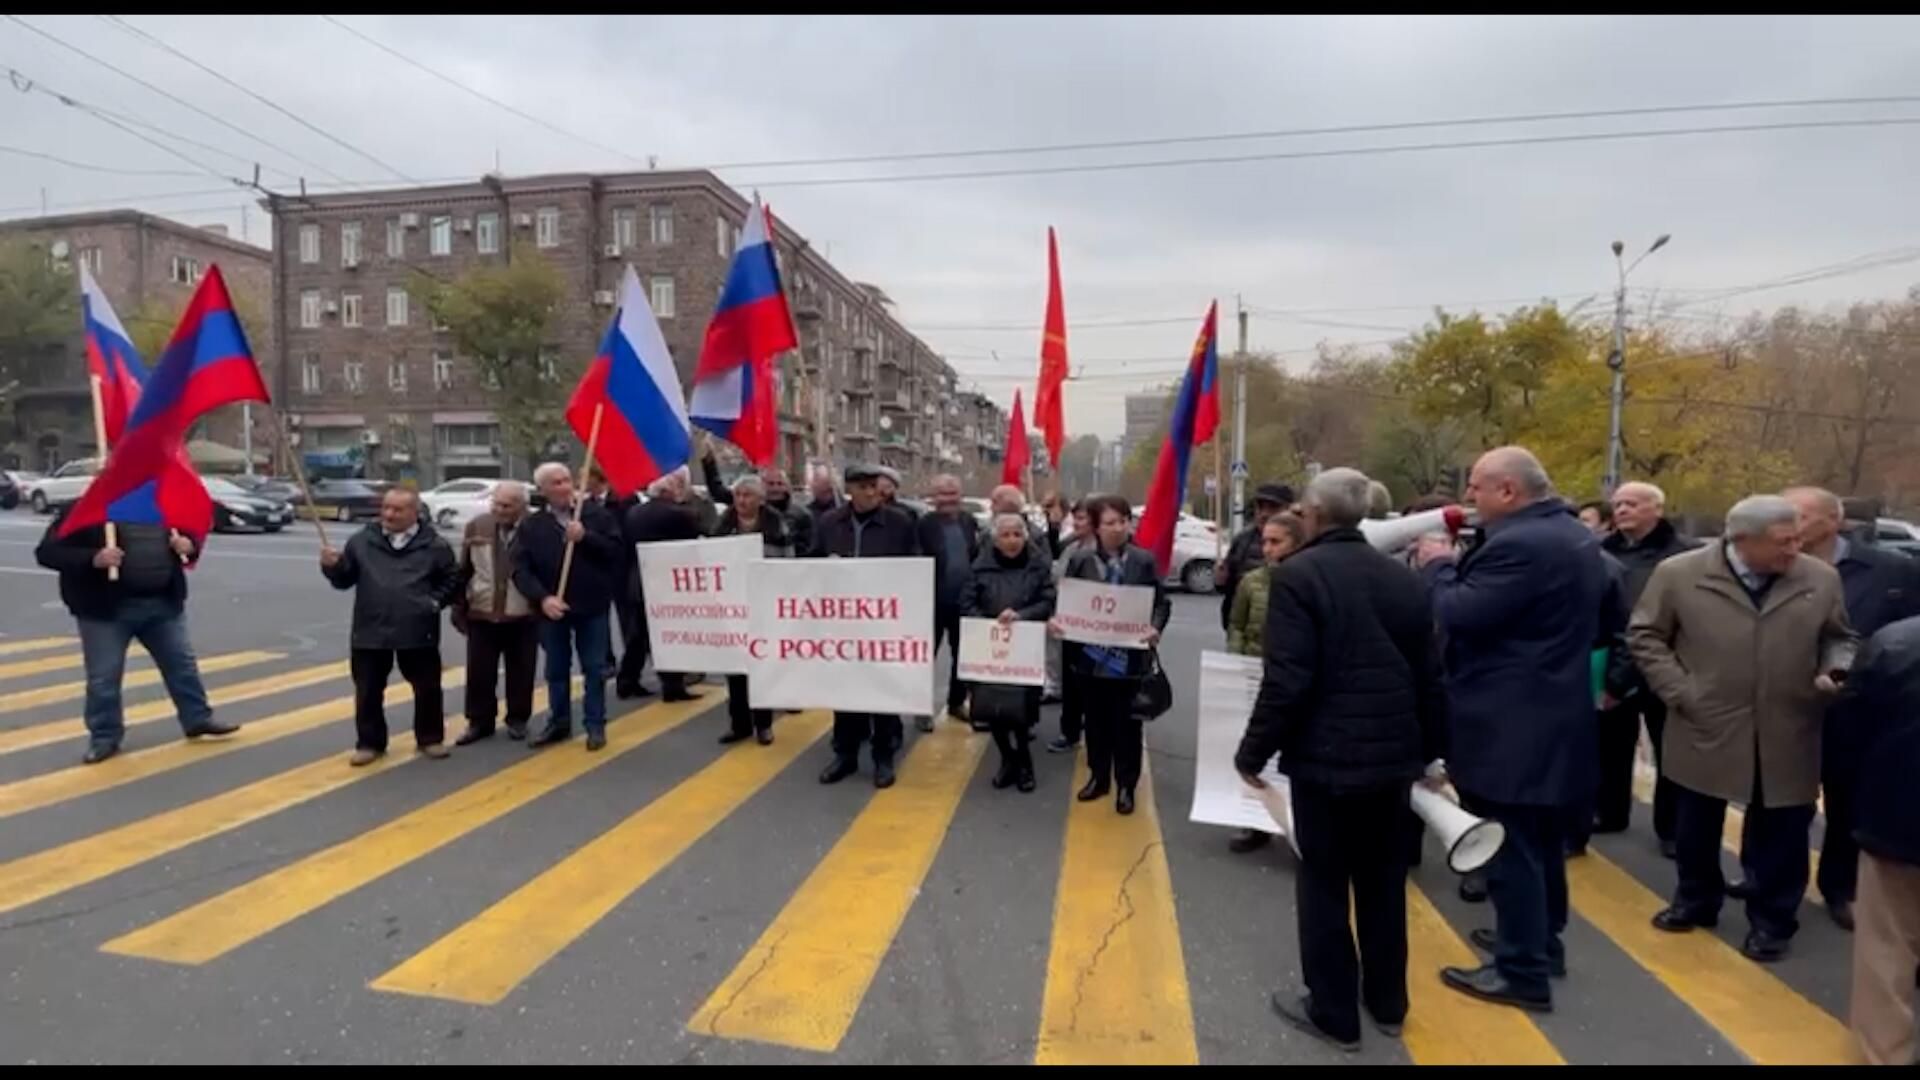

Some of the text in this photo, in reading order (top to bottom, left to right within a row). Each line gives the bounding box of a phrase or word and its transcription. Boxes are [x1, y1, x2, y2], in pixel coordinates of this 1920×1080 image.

[672, 567, 727, 592] НЕТ
[650, 604, 749, 620] АНТИРОССИЙСКИ
[777, 598, 899, 620] НАВЕКИ
[749, 636, 928, 663] С РОССИЕЙ!
